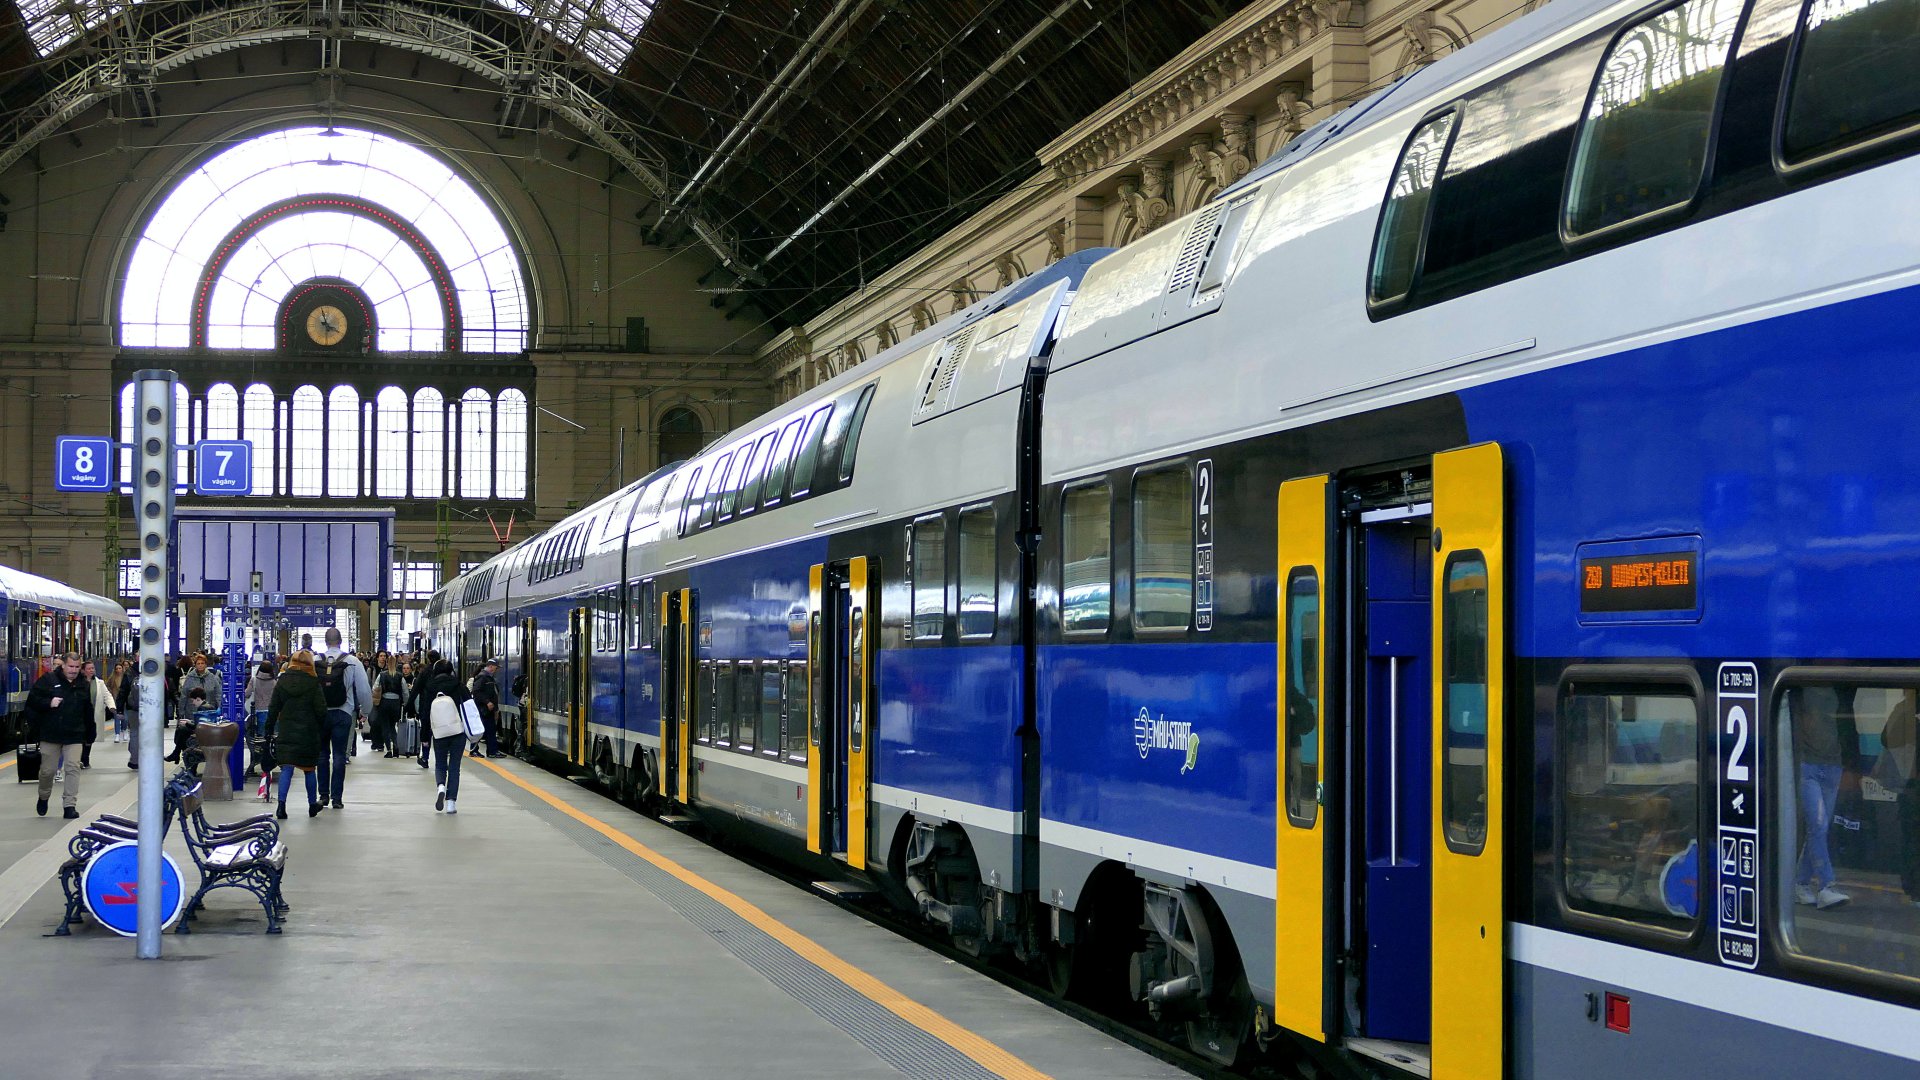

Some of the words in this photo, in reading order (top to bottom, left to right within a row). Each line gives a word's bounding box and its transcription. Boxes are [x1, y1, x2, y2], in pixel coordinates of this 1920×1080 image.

[75, 446, 94, 474] 8
[215, 450, 233, 477] 7
[71, 474, 97, 483] vágány
[211, 478, 236, 486] vágány
[1199, 467, 1209, 515] 2
[906, 529, 911, 562] 2
[1611, 560, 1689, 588] BUDAPEST-KELETI
[232, 594, 239, 602] 8
[252, 594, 260, 602] B
[273, 594, 280, 602] 7
[1152, 713, 1192, 751] MÁV-START
[1726, 705, 1749, 781] 2
